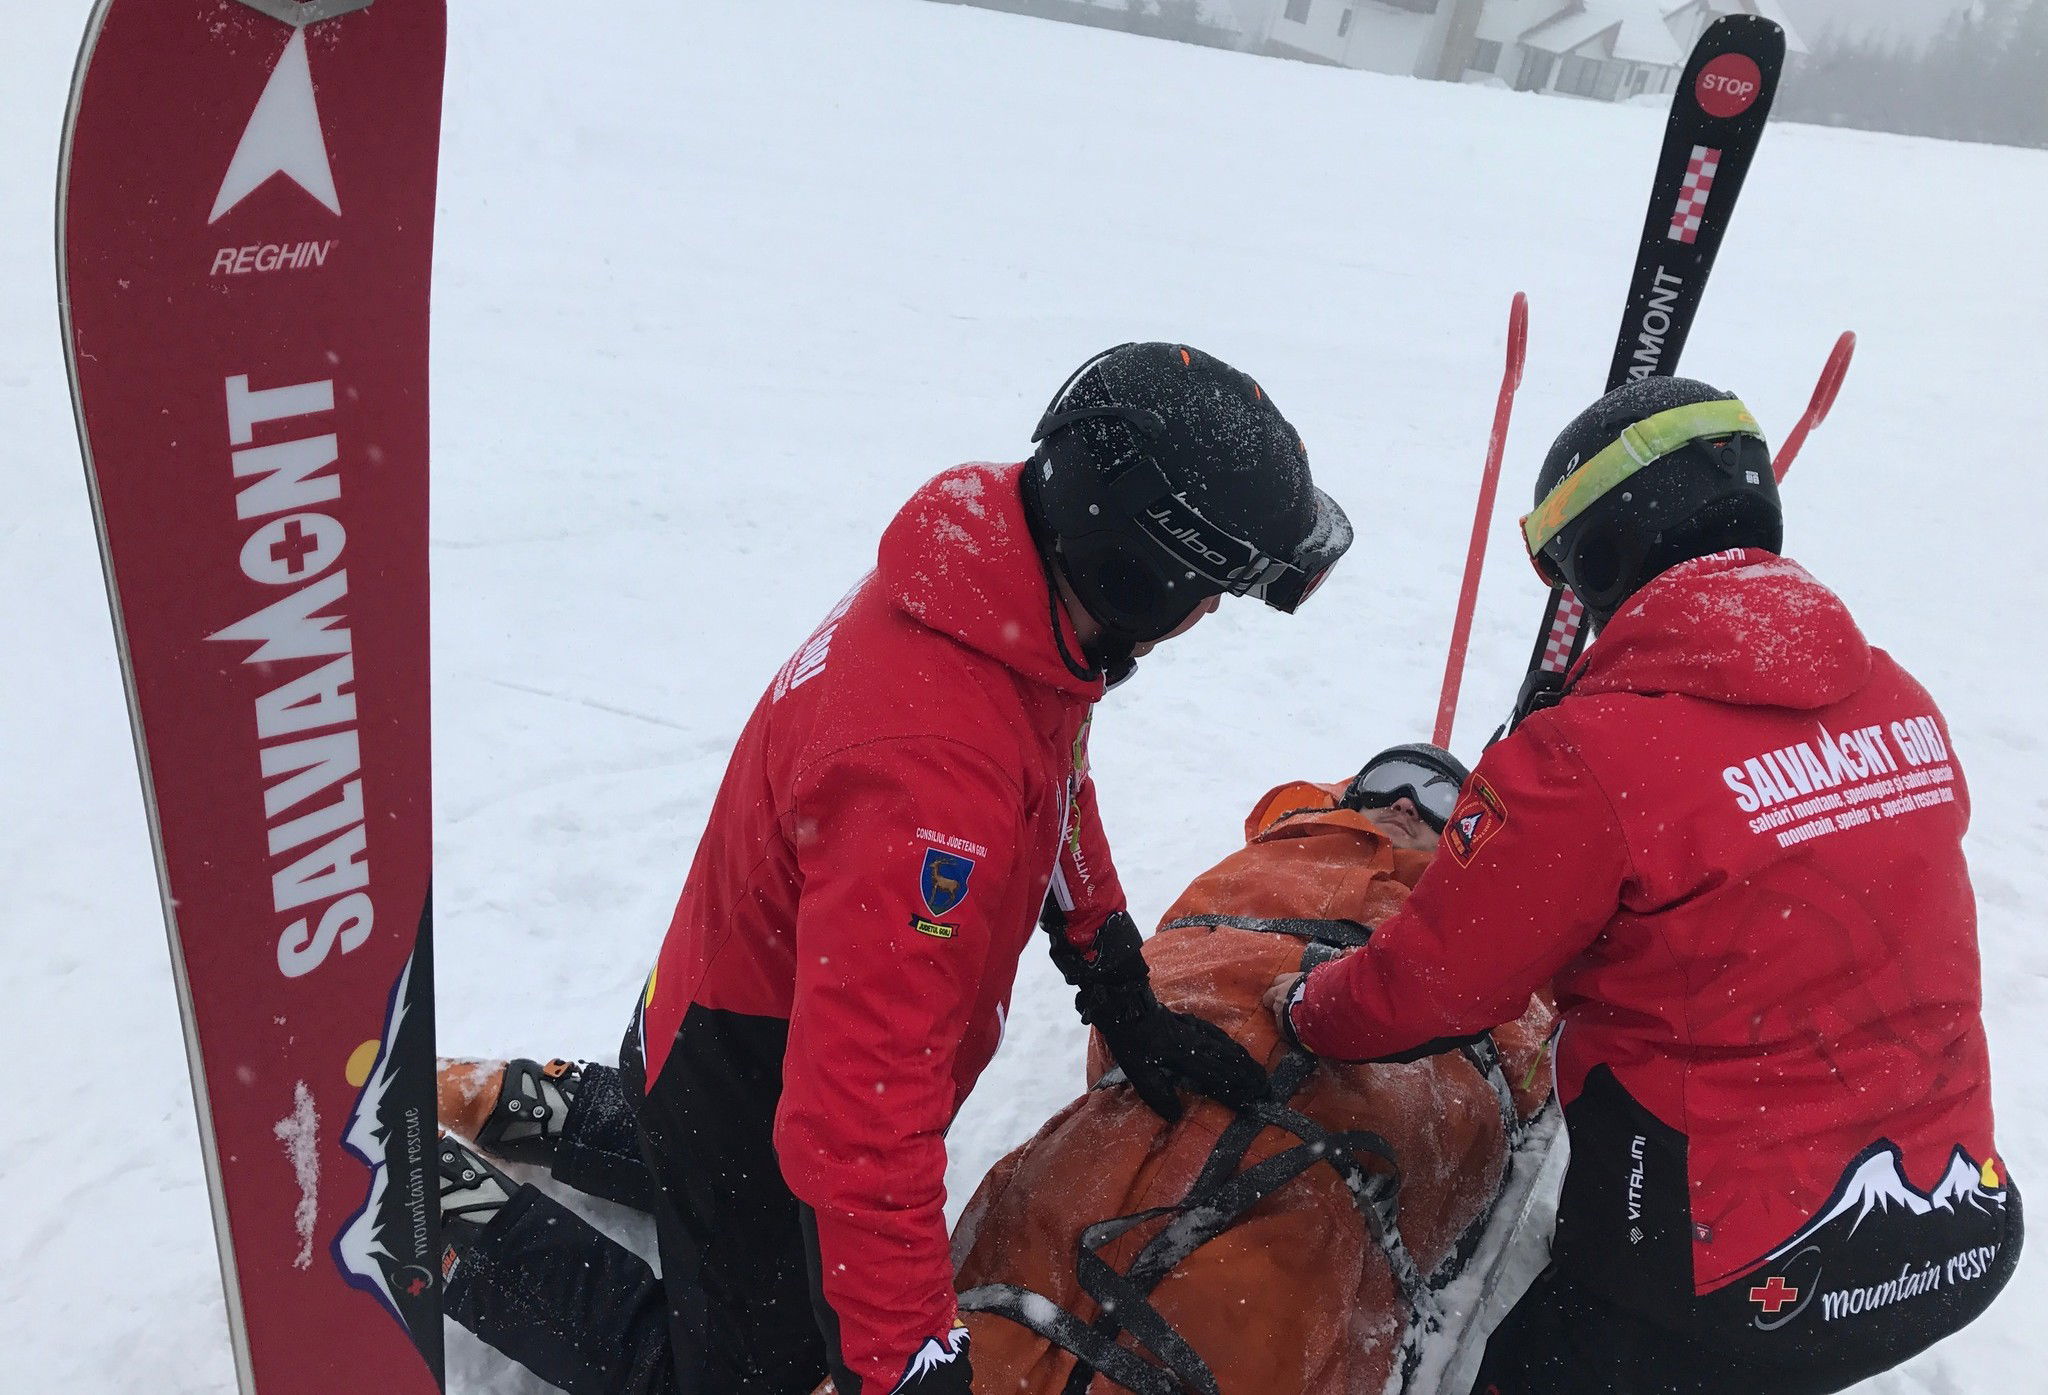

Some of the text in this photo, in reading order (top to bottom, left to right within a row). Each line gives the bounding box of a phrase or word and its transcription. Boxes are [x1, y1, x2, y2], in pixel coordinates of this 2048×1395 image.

[1702, 73, 1754, 97] STOP
[209, 240, 331, 275] REGHIN
[1146, 507, 1227, 567] Julbo
[202, 374, 375, 978] SALVAMONT
[1722, 720, 1899, 813] SALVAMONT
[1776, 816, 1838, 849] mountain,
[1835, 807, 1871, 831] speleo
[1871, 805, 1881, 820] &
[1880, 793, 1917, 819] special
[404, 1107, 429, 1258] mountain rescue
[1628, 1135, 1647, 1220] VITALINI
[1821, 1260, 1941, 1322] mountain
